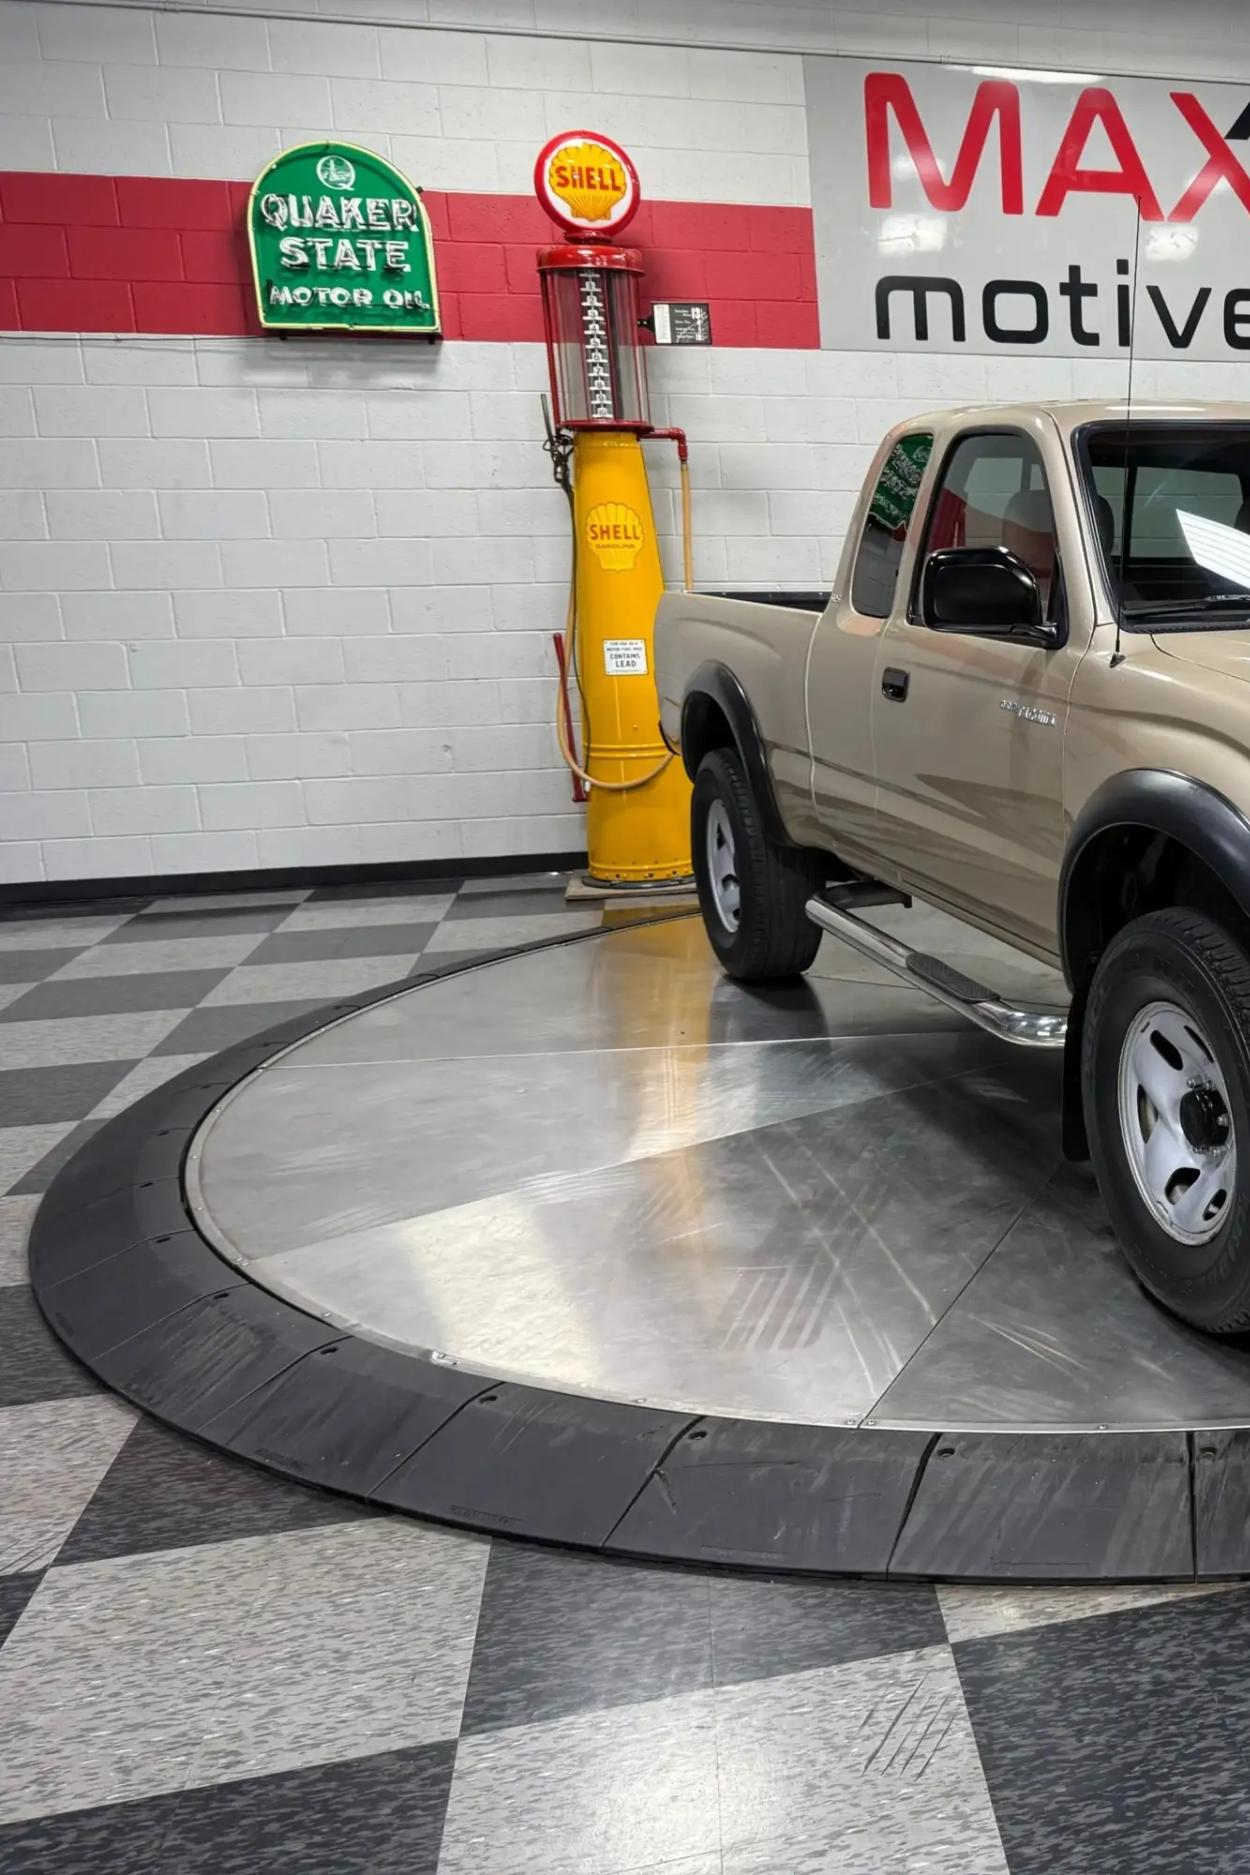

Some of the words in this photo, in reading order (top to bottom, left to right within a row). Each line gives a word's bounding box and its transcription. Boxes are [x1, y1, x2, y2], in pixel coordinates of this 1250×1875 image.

[555, 165, 622, 192] SHELL
[261, 193, 419, 232] QUAKER
[279, 236, 412, 272] STATE
[270, 286, 373, 308] MOTOR
[383, 288, 430, 310] OIL
[590, 524, 640, 540] SHELL
[609, 653, 641, 661] CONTAINS
[615, 660, 637, 668] LEAD
